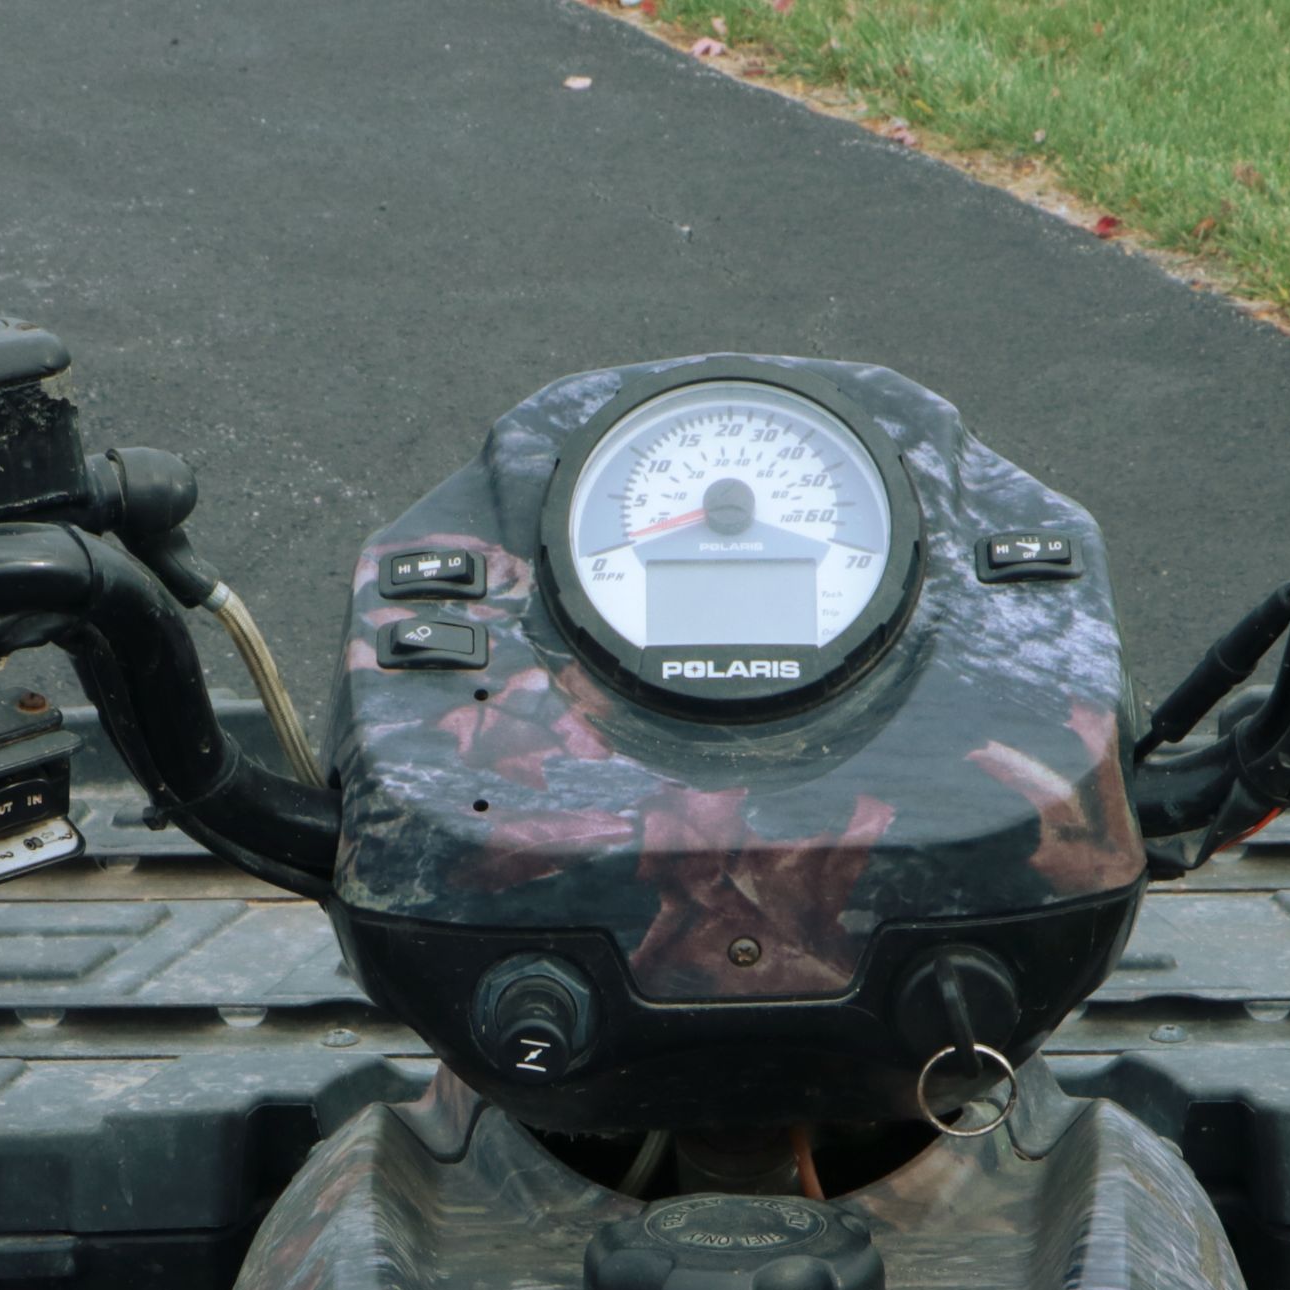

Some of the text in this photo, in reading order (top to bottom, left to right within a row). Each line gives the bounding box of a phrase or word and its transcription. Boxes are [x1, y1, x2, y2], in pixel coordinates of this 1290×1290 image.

[714, 423, 743, 437] 20
[749, 428, 779, 442] 30
[678, 434, 701, 447] 15
[776, 446, 805, 460] 40
[648, 460, 672, 473] 10
[713, 459, 730, 467] 30
[734, 458, 750, 466] 40
[688, 470, 705, 479] 20
[798, 473, 828, 487] 50
[633, 494, 648, 507] 5
[672, 492, 687, 501] 10
[771, 490, 789, 499] 80
[780, 514, 802, 522] 100
[804, 509, 835, 522] 60
[699, 542, 764, 551] POLARIS
[996, 541, 1062, 554] HI LO
[398, 557, 461, 574] HI LO
[592, 558, 607, 571] 0
[845, 555, 872, 569] 70
[424, 569, 437, 577] OFF
[662, 660, 800, 679] POLARIS
[27, 794, 42, 806] IN
